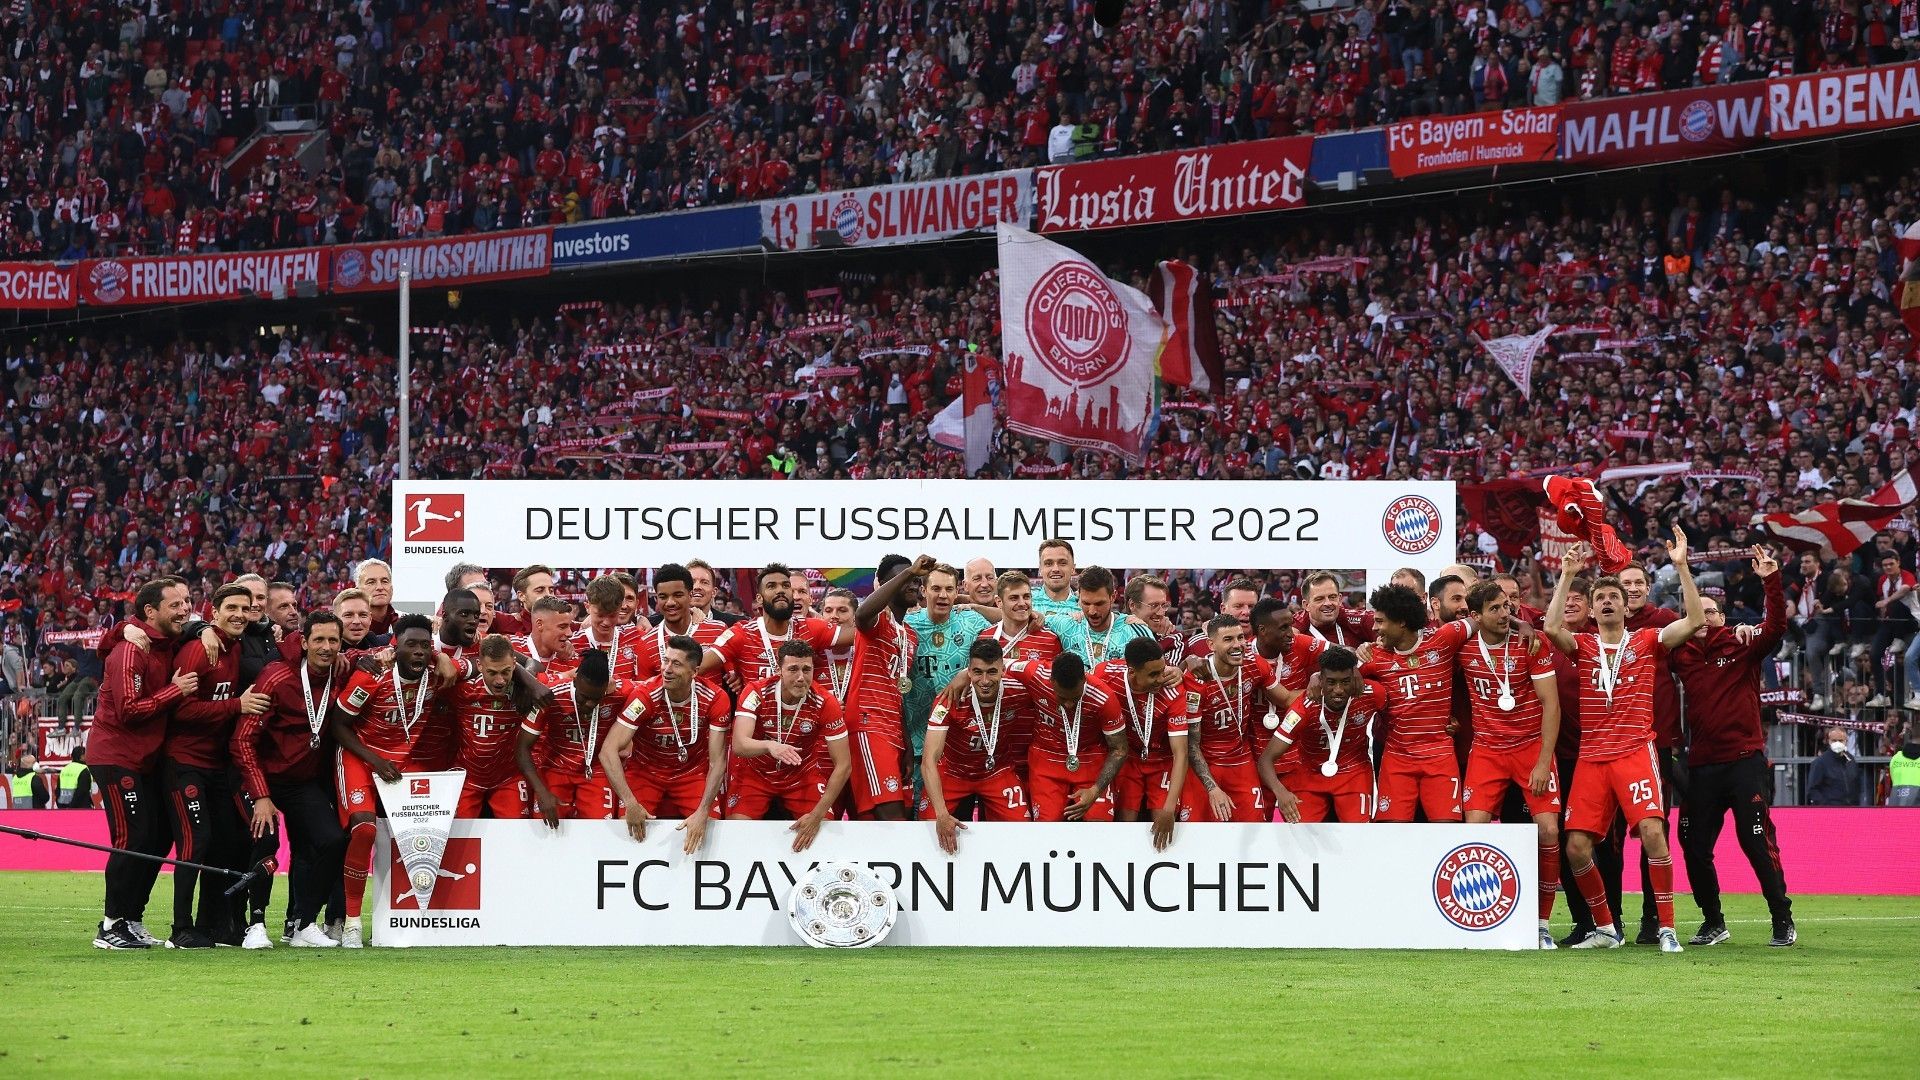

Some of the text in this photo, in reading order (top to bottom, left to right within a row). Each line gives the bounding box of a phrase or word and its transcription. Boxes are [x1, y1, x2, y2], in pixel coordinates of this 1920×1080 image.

[1769, 67, 1920, 132] RABENA
[1390, 124, 1414, 151] FC
[1420, 116, 1484, 153] Bayern
[1501, 108, 1556, 137] Schar
[1417, 149, 1469, 169] Fronhofen
[1476, 143, 1524, 160] Hunsrück
[1036, 153, 1305, 230] Lipsia United
[771, 207, 798, 250] 13
[370, 233, 547, 284] SCHLOSSPANTHER
[554, 232, 630, 258] nvestors
[0, 270, 70, 300] RCHEN
[131, 251, 319, 297] FRIEDRICHSHAFEN
[1038, 271, 1123, 329] QUEERPASS
[1049, 347, 1107, 376] BAYERN
[1387, 499, 1437, 521] FC BAYERN
[526, 507, 1319, 541] DEUTSCHER FUSSBALLMEISTER 2022
[404, 546, 465, 554] BUNDESLIGA
[1388, 529, 1437, 550] MÜNCHEN
[518, 781, 528, 801] 6
[1161, 772, 1170, 791] 4
[1451, 778, 1458, 799] 7
[1629, 779, 1652, 804] 25
[603, 787, 612, 808] 3
[1003, 786, 1027, 808] 22
[391, 810, 451, 818] FUSSBALLMEISTER
[1440, 848, 1513, 881] FC BAYERN
[597, 859, 670, 911] FC
[981, 850, 1320, 912] MÜNCHEN
[389, 917, 481, 929] BUNDESLIGA
[1441, 895, 1513, 926] MÜNCHEN
